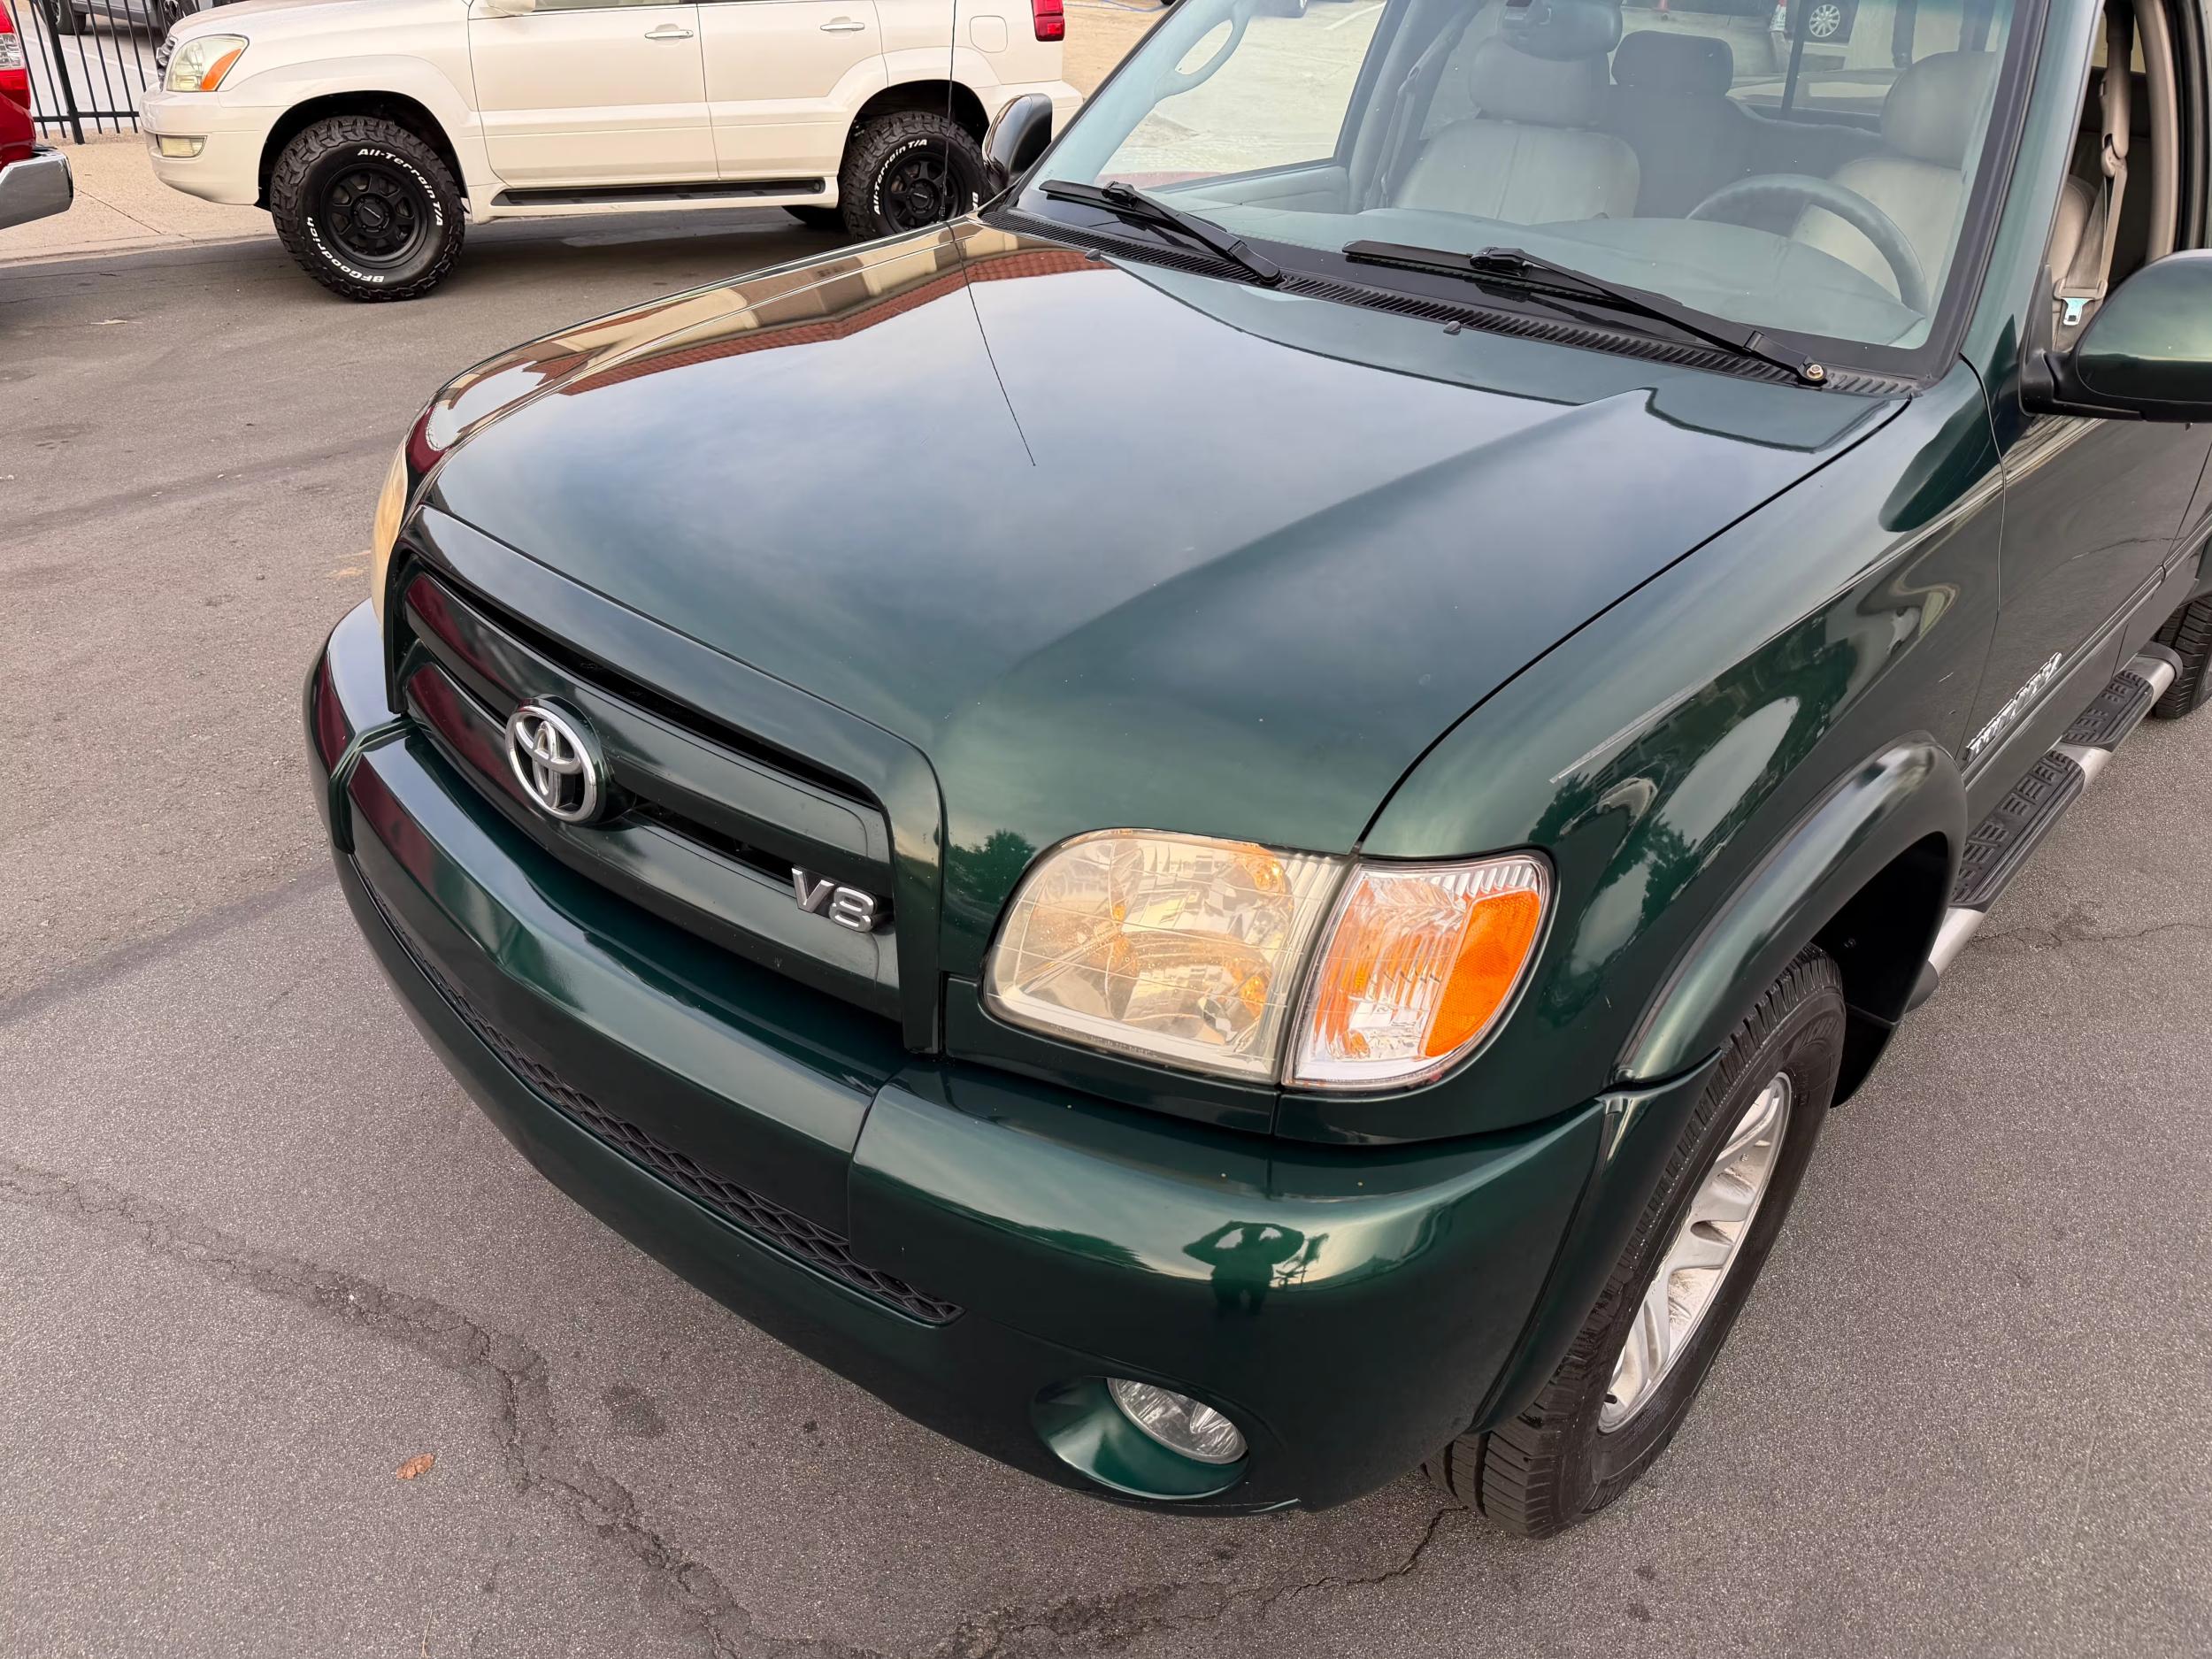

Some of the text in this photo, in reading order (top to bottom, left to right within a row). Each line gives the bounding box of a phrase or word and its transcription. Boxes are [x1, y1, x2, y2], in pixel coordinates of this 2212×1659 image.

[357, 149, 443, 227] All-Terrain T/A
[873, 139, 927, 215] All-Terrain T/A
[307, 217, 385, 282] BFGoodrich
[791, 867, 877, 933] V8
